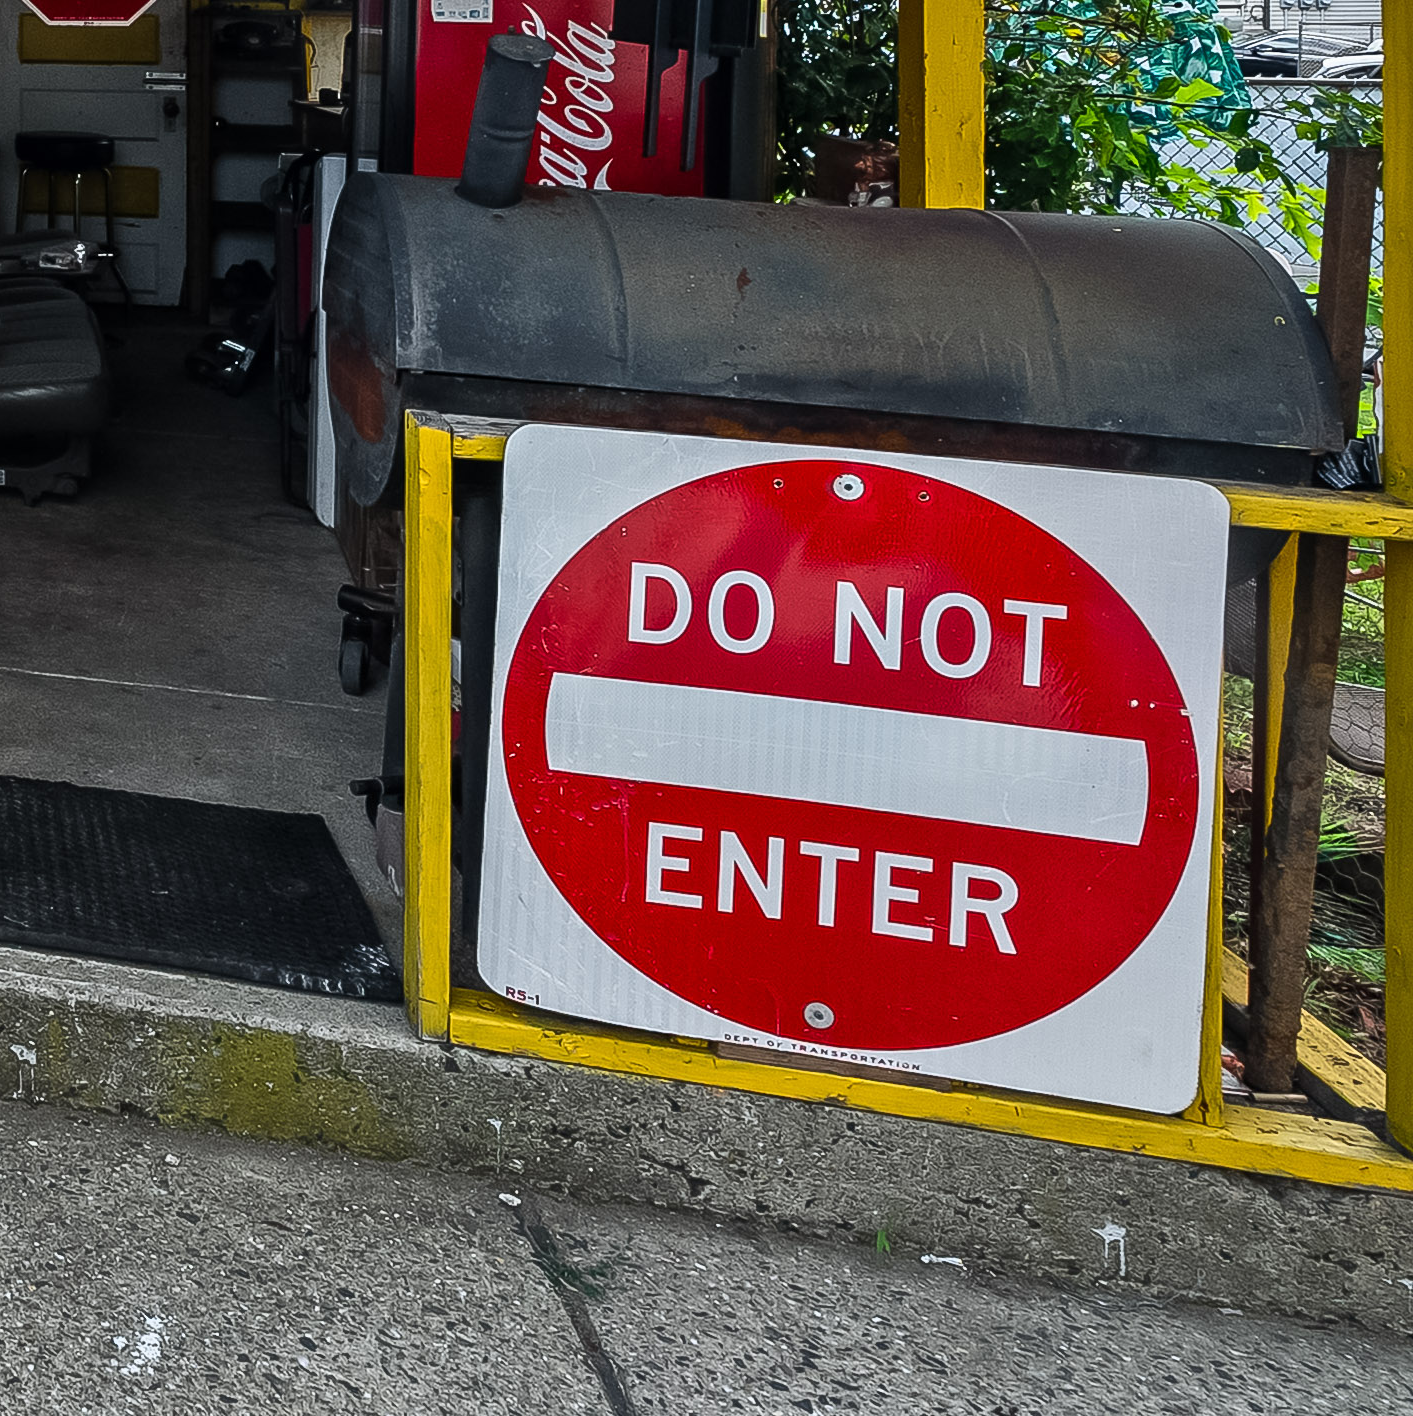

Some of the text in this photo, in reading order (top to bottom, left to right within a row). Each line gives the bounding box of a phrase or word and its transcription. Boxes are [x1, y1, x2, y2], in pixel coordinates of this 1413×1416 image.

[626, 560, 1070, 687] DO NOT
[643, 821, 1021, 956] ENTER
[724, 1033, 759, 1045] DEPT
[790, 1043, 921, 1071] TRANSPORTATION
